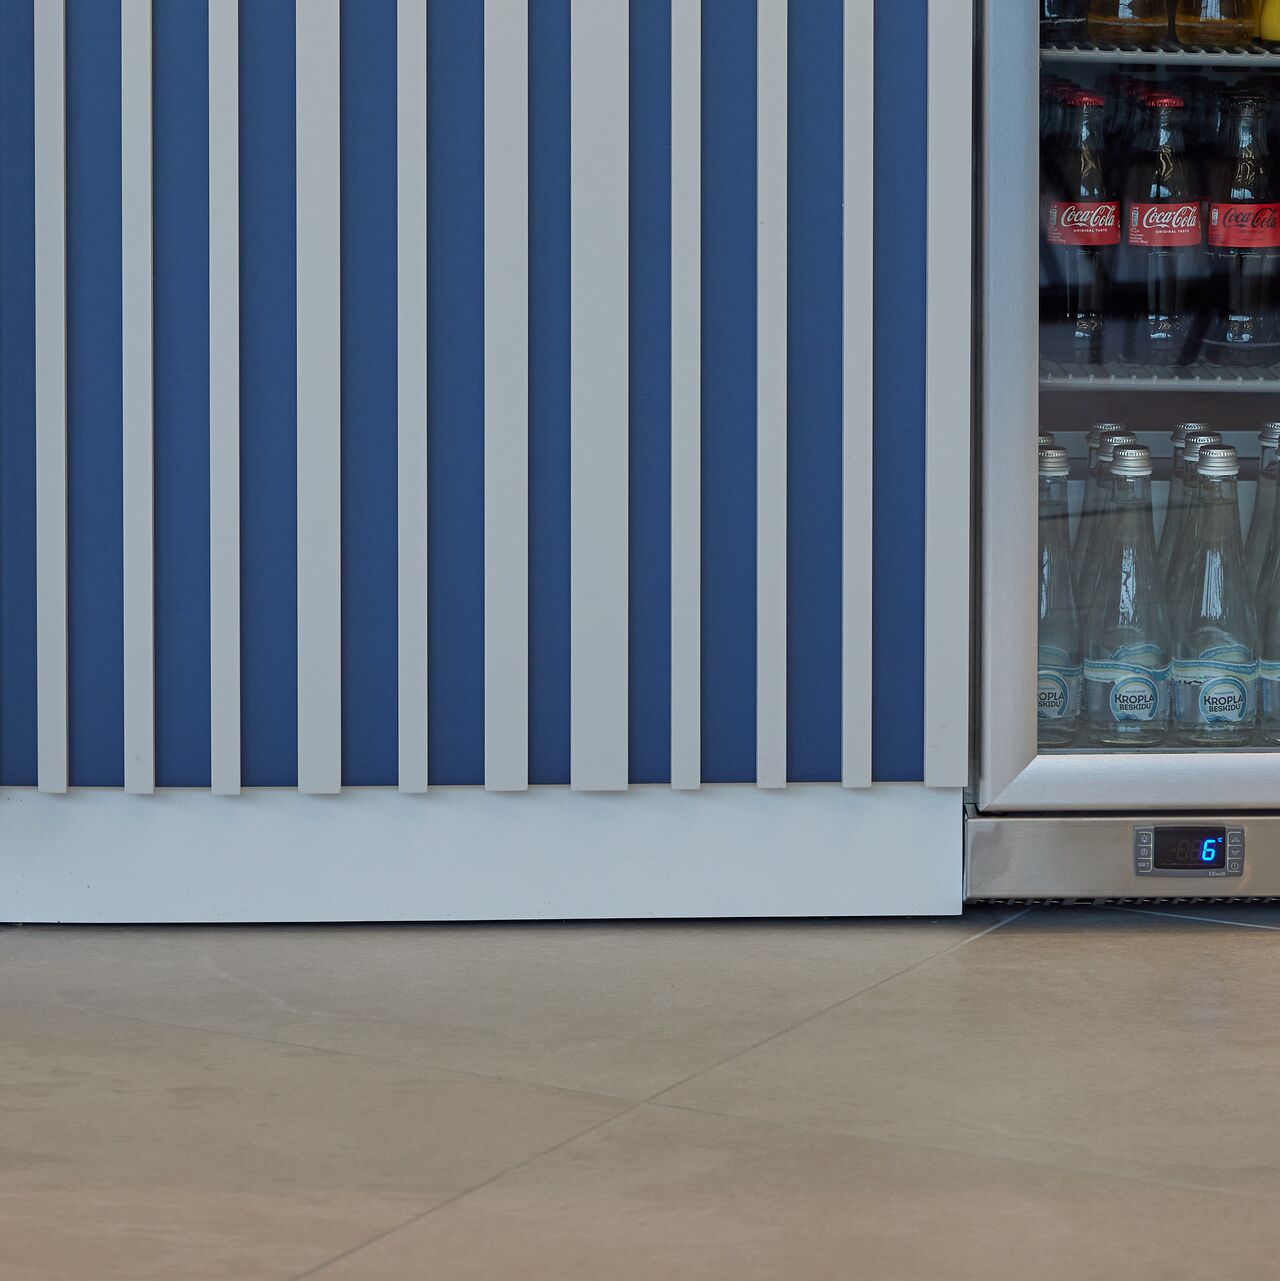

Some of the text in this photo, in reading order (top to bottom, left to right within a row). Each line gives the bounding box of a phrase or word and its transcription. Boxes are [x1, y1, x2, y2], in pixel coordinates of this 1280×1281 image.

[1061, 205, 1116, 228] Coca-Cola
[1142, 206, 1198, 229] Coca-Cola
[1222, 207, 1278, 229] Coca-Cola
[1037, 692, 1065, 701] OPLA
[1114, 693, 1155, 704] KROPLA
[1203, 694, 1244, 706] KROPLA
[1038, 700, 1062, 708] SKIDU
[1119, 702, 1151, 711] BESKIDU
[1208, 703, 1240, 713] BESKIDU
[1202, 839, 1216, 861] 6
